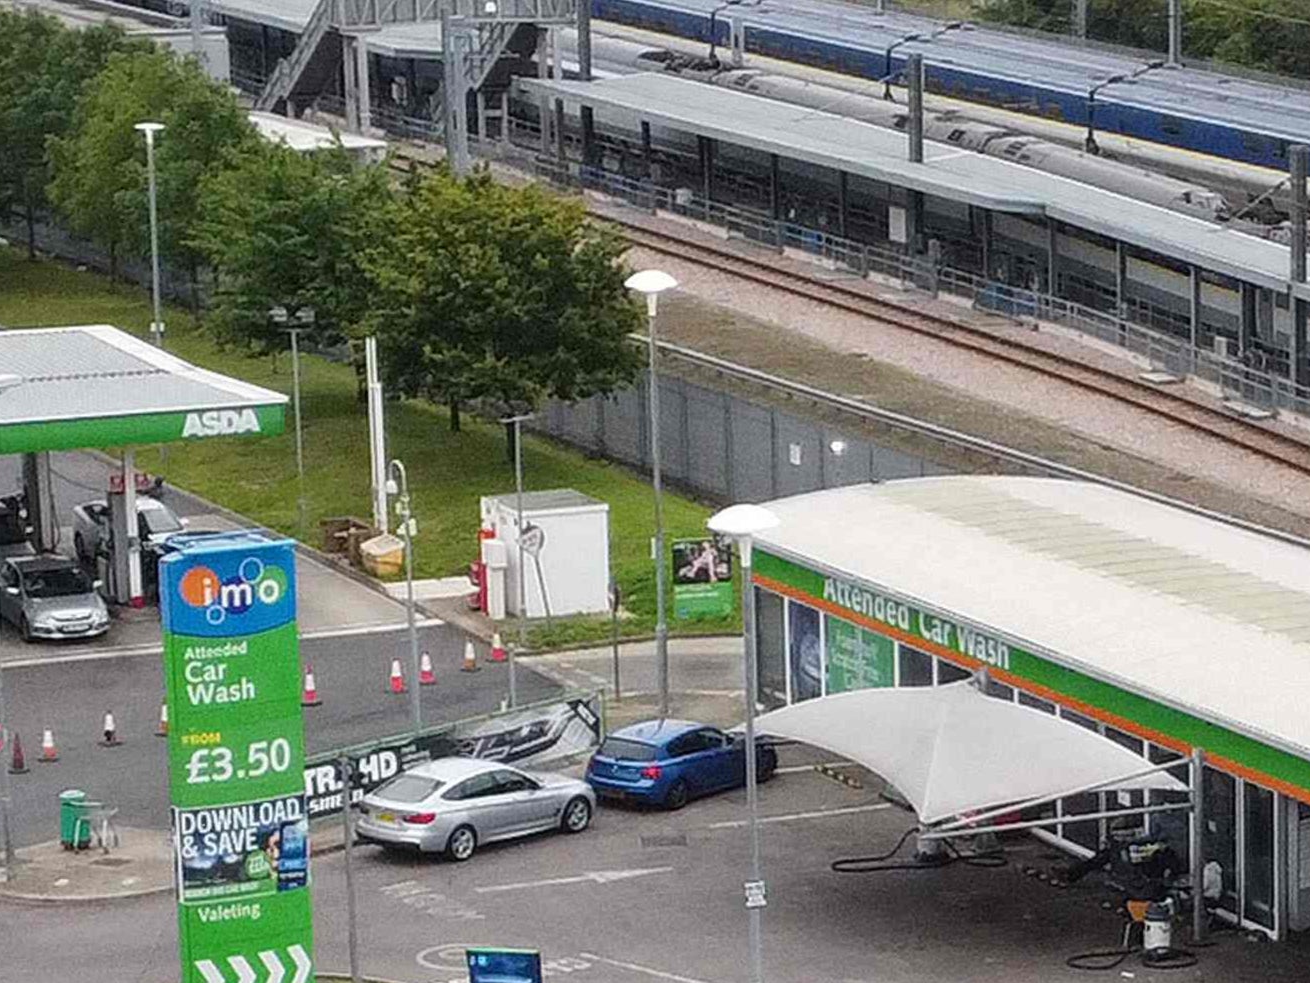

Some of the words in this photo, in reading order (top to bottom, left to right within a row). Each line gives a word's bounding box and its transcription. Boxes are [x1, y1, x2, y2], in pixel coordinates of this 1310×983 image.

[181, 408, 262, 437] ASDA
[203, 577, 280, 608] imo
[823, 577, 910, 631] Attended
[918, 611, 952, 645] Car
[957, 626, 1010, 670] Wash
[184, 641, 248, 660] Attended
[185, 661, 227, 683] Car
[187, 679, 256, 706] Wash
[186, 738, 291, 784] £3.50
[182, 798, 303, 835] DOWNLOAD
[182, 835, 199, 858] &
[204, 829, 259, 855] SAVE
[198, 903, 261, 923] Valeting
